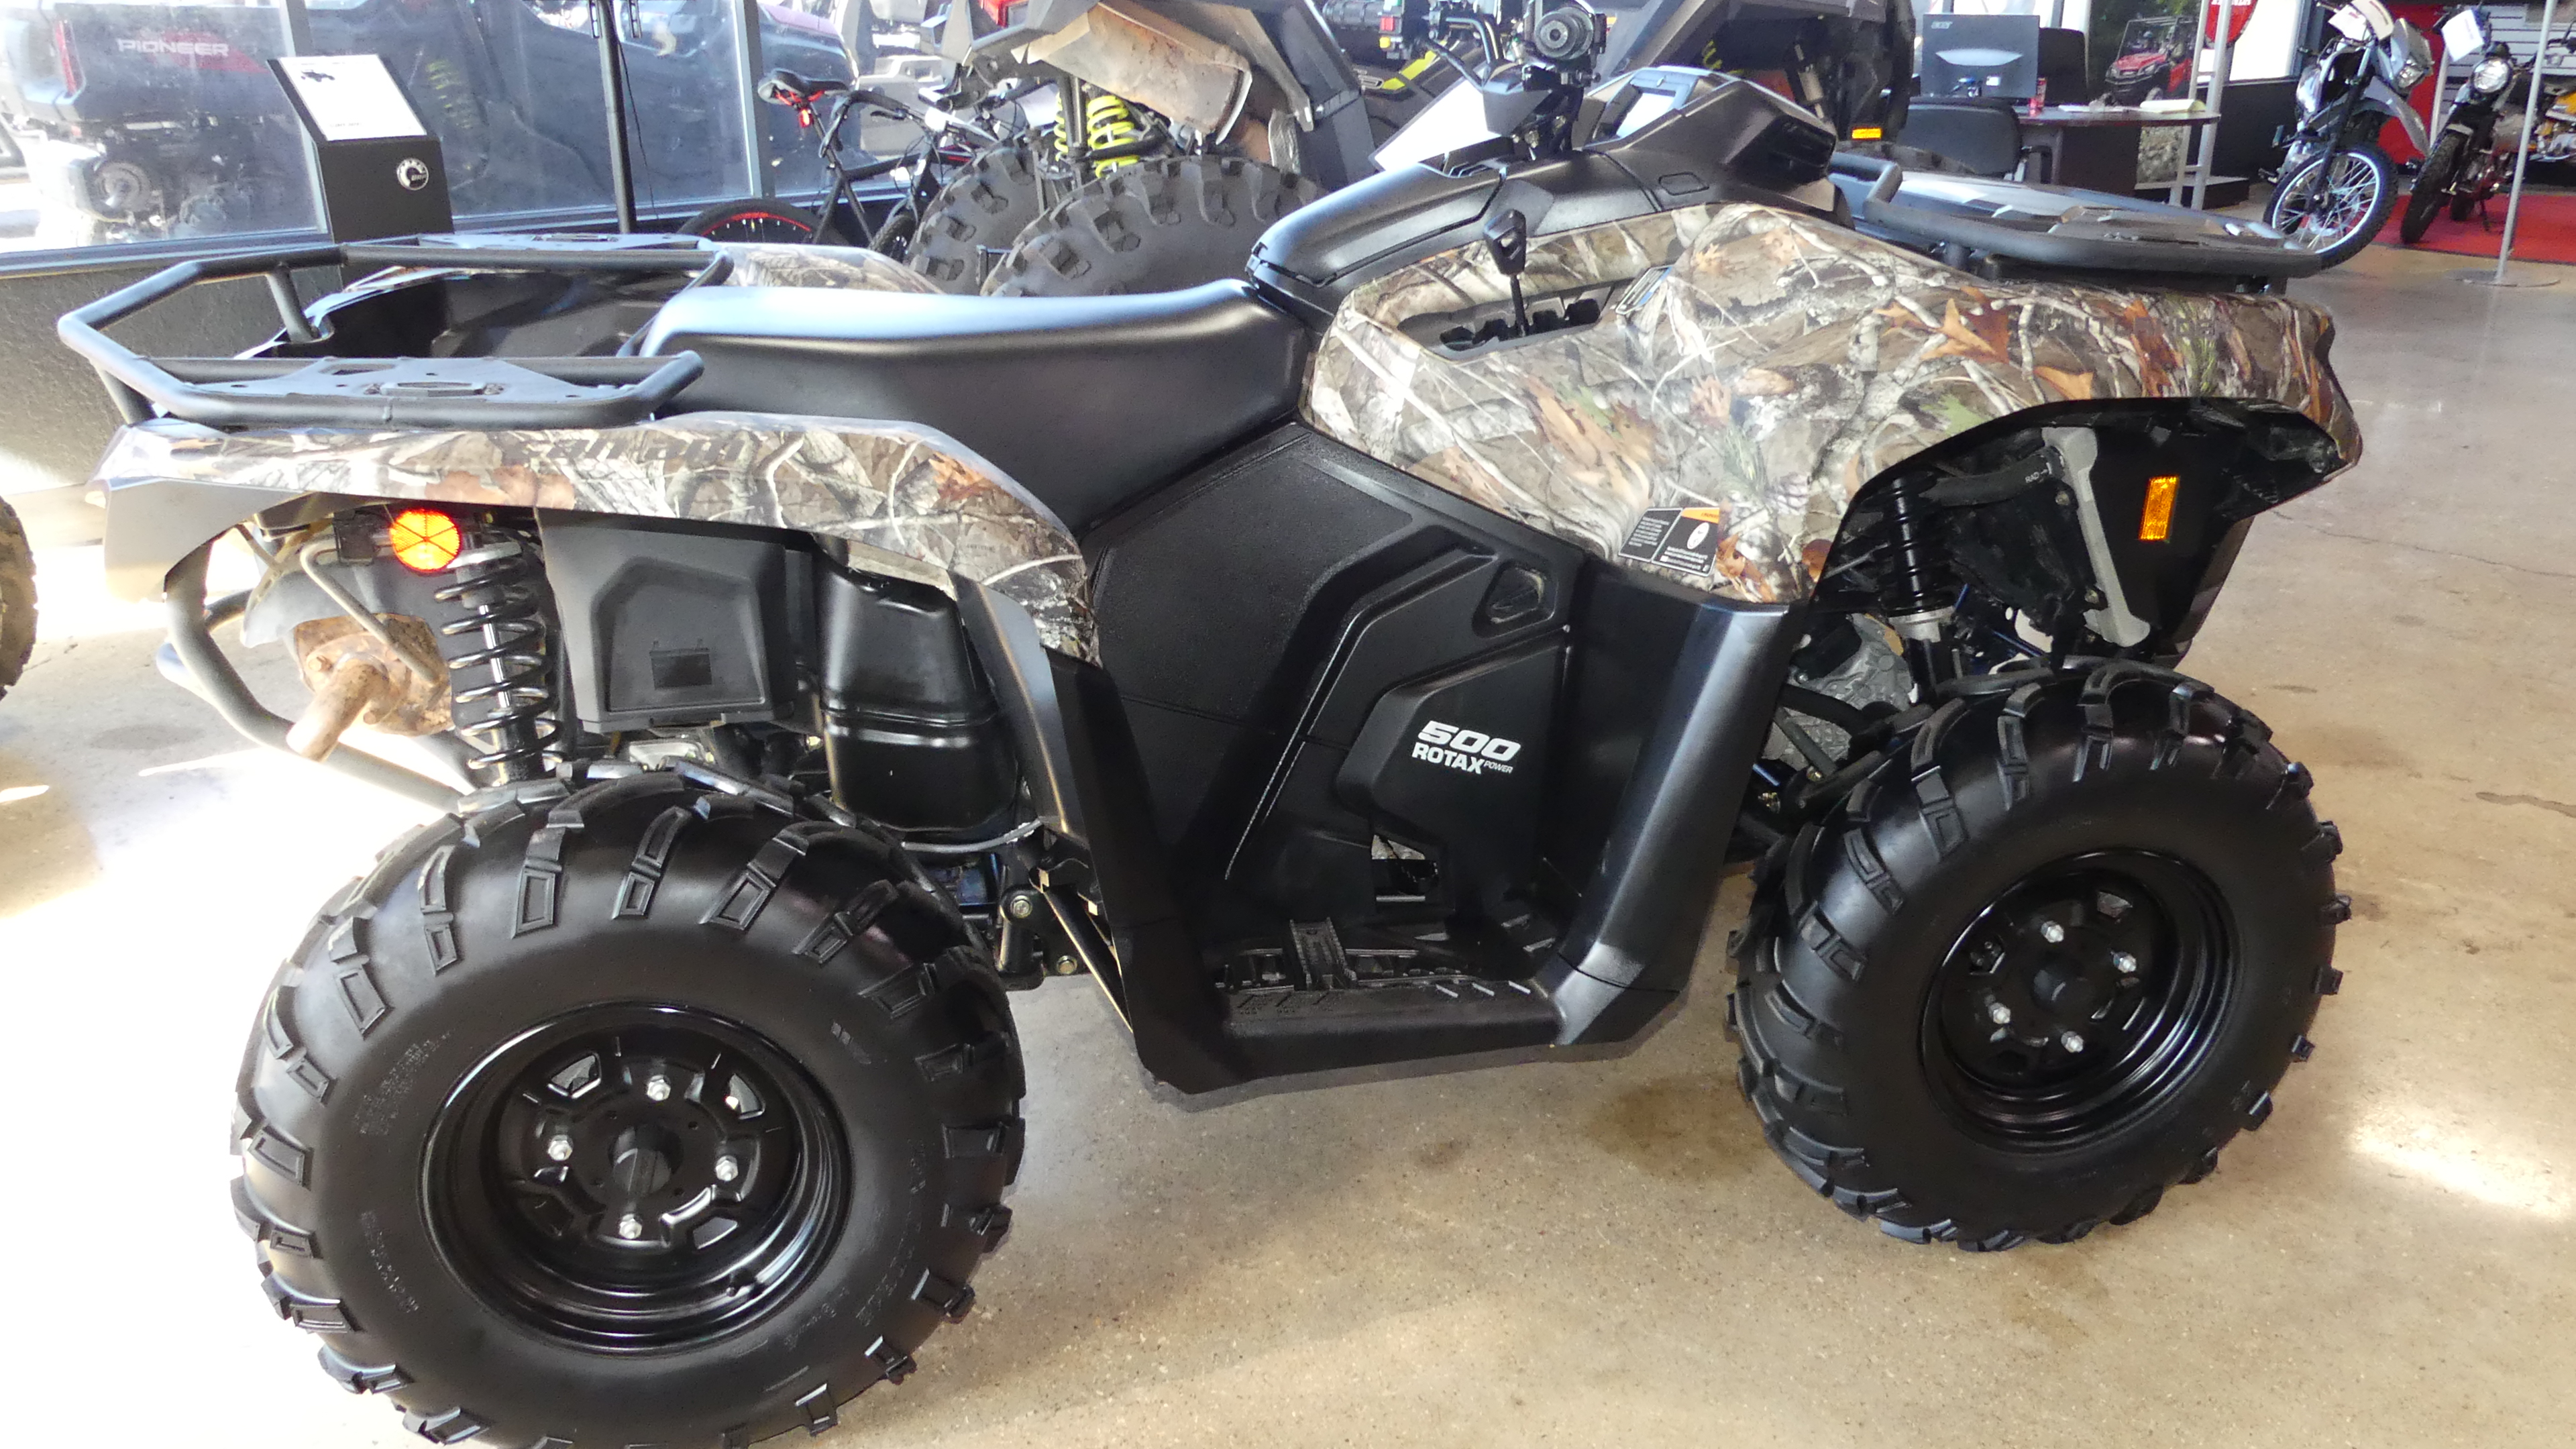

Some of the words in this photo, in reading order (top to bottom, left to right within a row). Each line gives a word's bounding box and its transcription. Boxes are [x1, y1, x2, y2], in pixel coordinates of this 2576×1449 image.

[115, 38, 229, 56] PIONEER
[2025, 471, 2040, 483] RAD
[1417, 720, 1521, 761] 500
[1411, 742, 1485, 774] ROTAX
[1484, 760, 1513, 774] POWER
